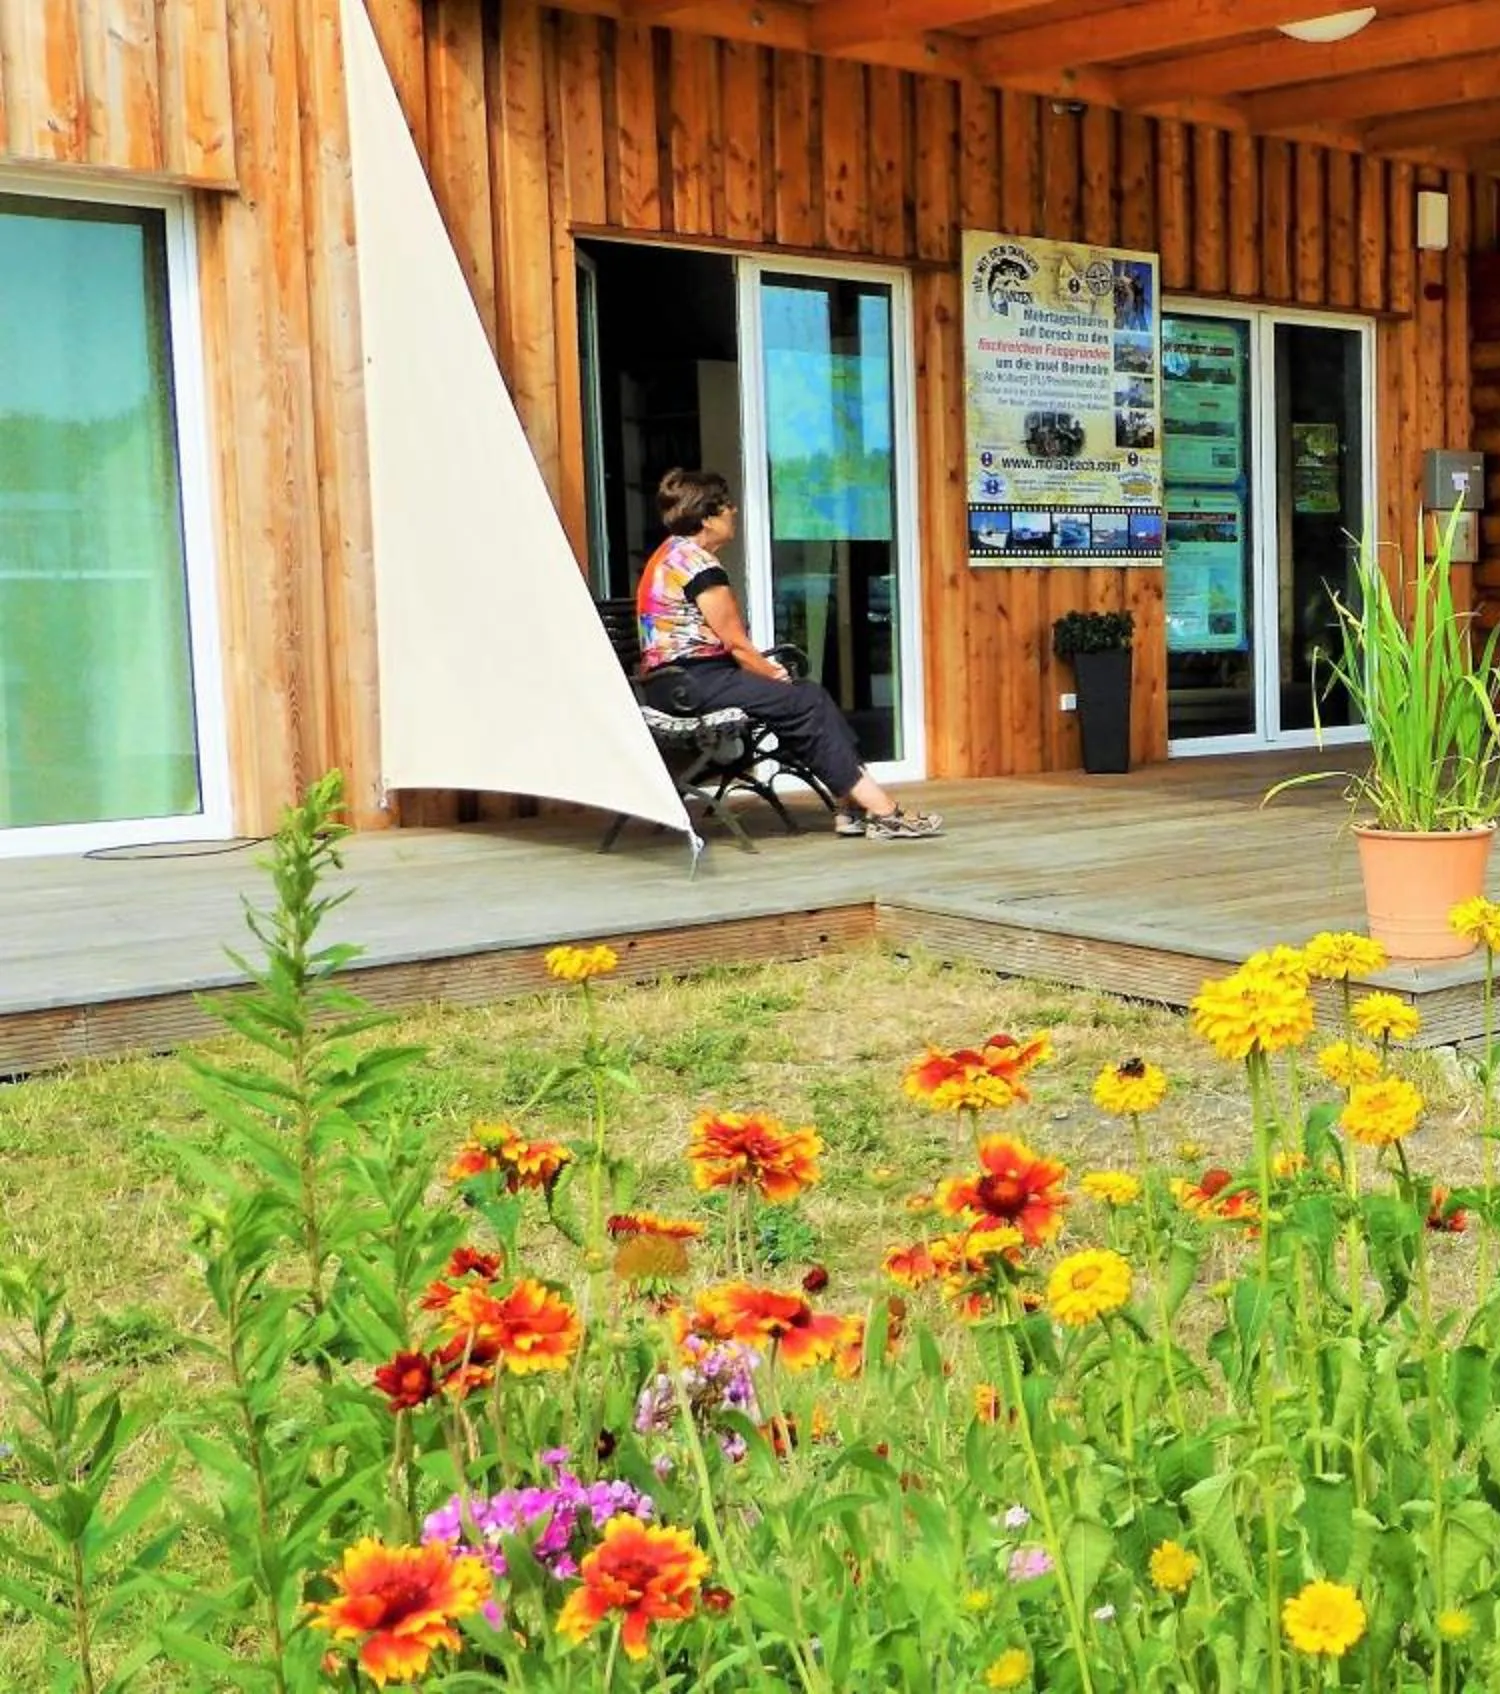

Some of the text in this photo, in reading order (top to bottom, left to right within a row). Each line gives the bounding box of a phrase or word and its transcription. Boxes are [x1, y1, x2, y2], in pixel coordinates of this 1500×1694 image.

[1019, 325, 1109, 344] auf Dorsch zu den
[995, 358, 1013, 368] um
[1015, 358, 1032, 370] die
[1001, 457, 1121, 472] www.molabeach.com
